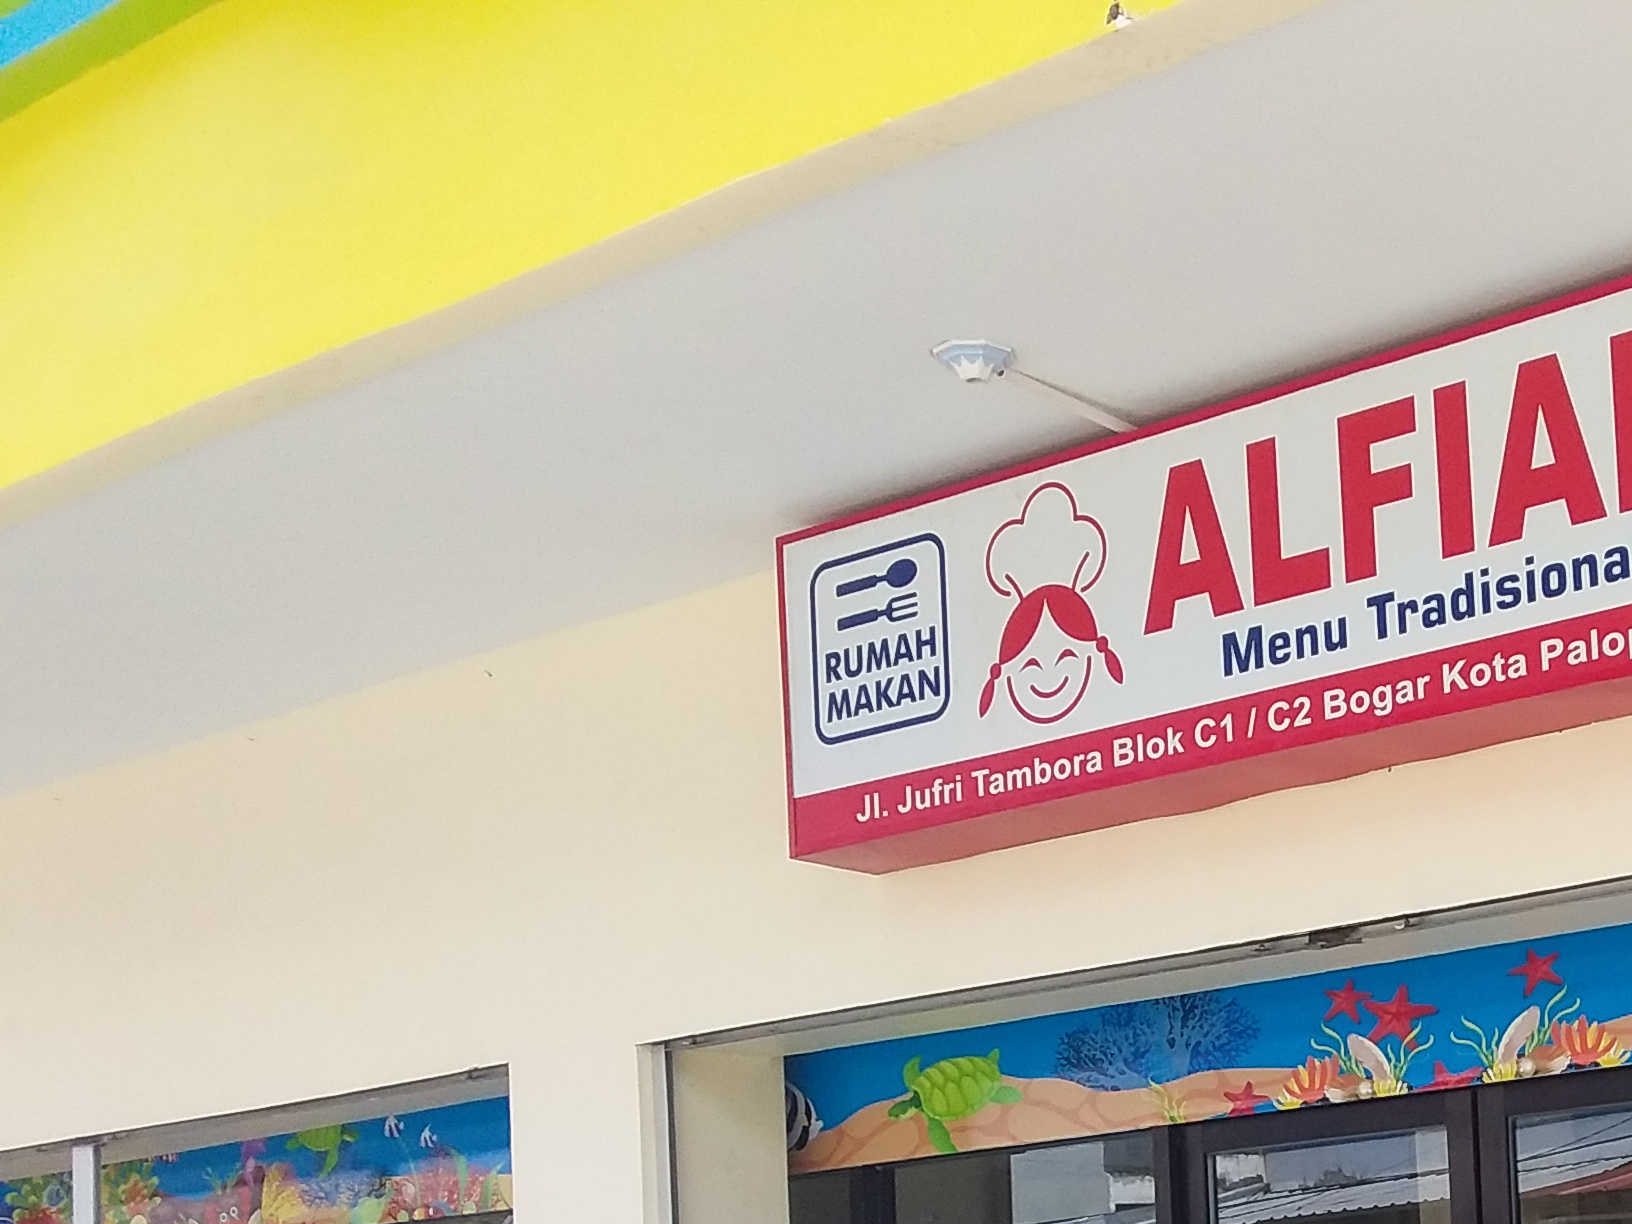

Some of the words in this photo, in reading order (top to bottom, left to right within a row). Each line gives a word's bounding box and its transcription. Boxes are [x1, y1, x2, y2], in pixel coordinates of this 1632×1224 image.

[825, 626, 937, 683] RUMAH
[1222, 617, 1348, 677] Menu
[826, 665, 941, 724] MAKAN
[856, 794, 889, 823] Jl.
[897, 776, 963, 815] Jufri
[971, 750, 1102, 797] Tambora
[1113, 727, 1186, 769] Blok
[1194, 712, 1235, 749] C1
[1247, 707, 1259, 738] /
[1267, 696, 1313, 732] C2
[1324, 672, 1431, 721] Bogar
[1442, 651, 1528, 695] Kota
